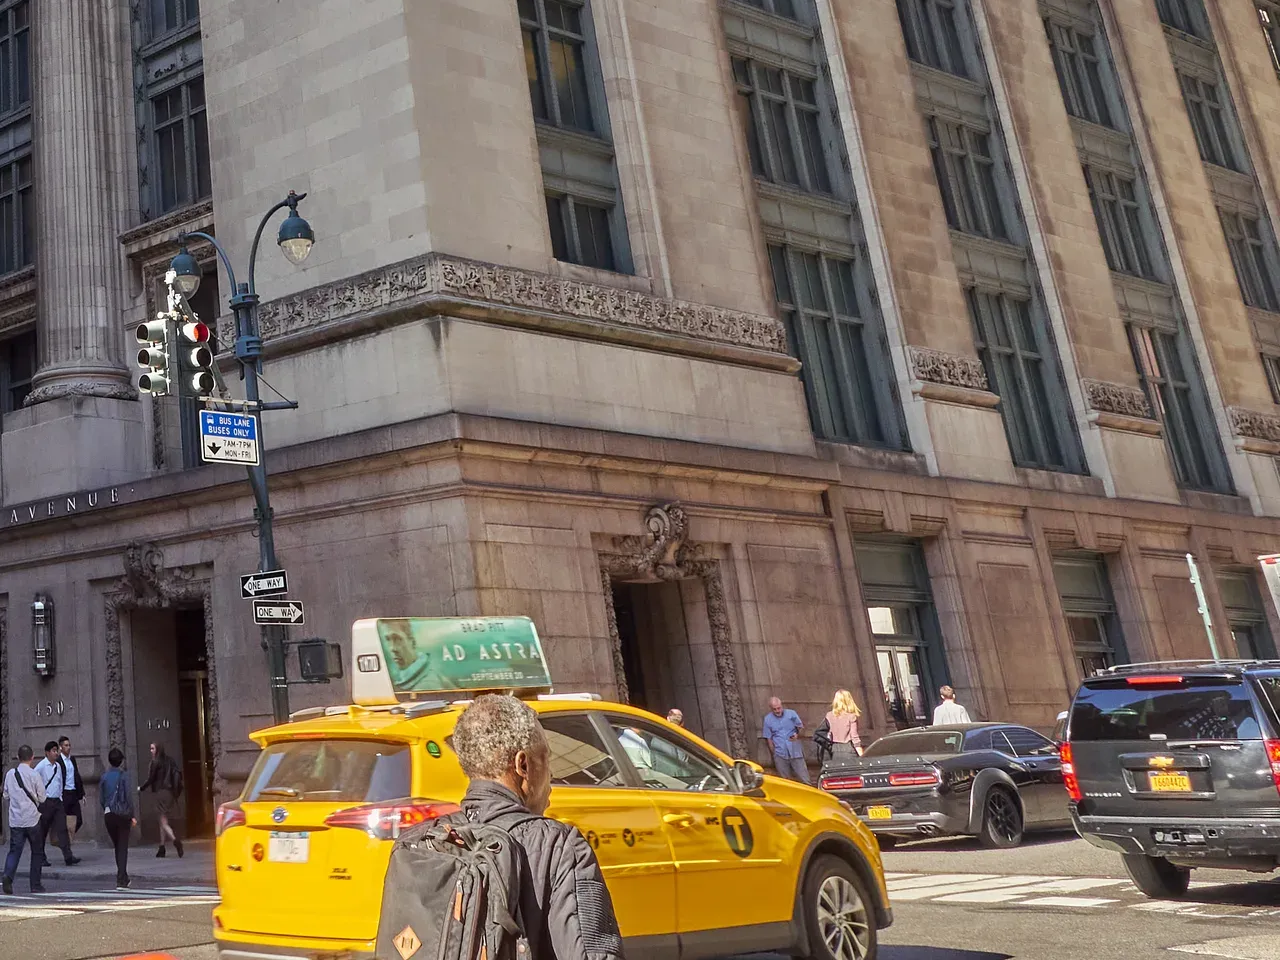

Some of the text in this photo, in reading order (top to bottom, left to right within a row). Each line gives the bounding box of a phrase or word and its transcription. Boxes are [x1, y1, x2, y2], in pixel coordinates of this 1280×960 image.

[218, 416, 251, 428] BUS LANE
[208, 425, 251, 438] BUSES ONLY
[9, 487, 121, 524] AVENUE
[247, 578, 282, 591] ONE WAY
[258, 607, 297, 618] ONE WAY
[461, 622, 486, 633] BRAD
[442, 642, 540, 662] AD ASTRA
[35, 699, 66, 717] 450
